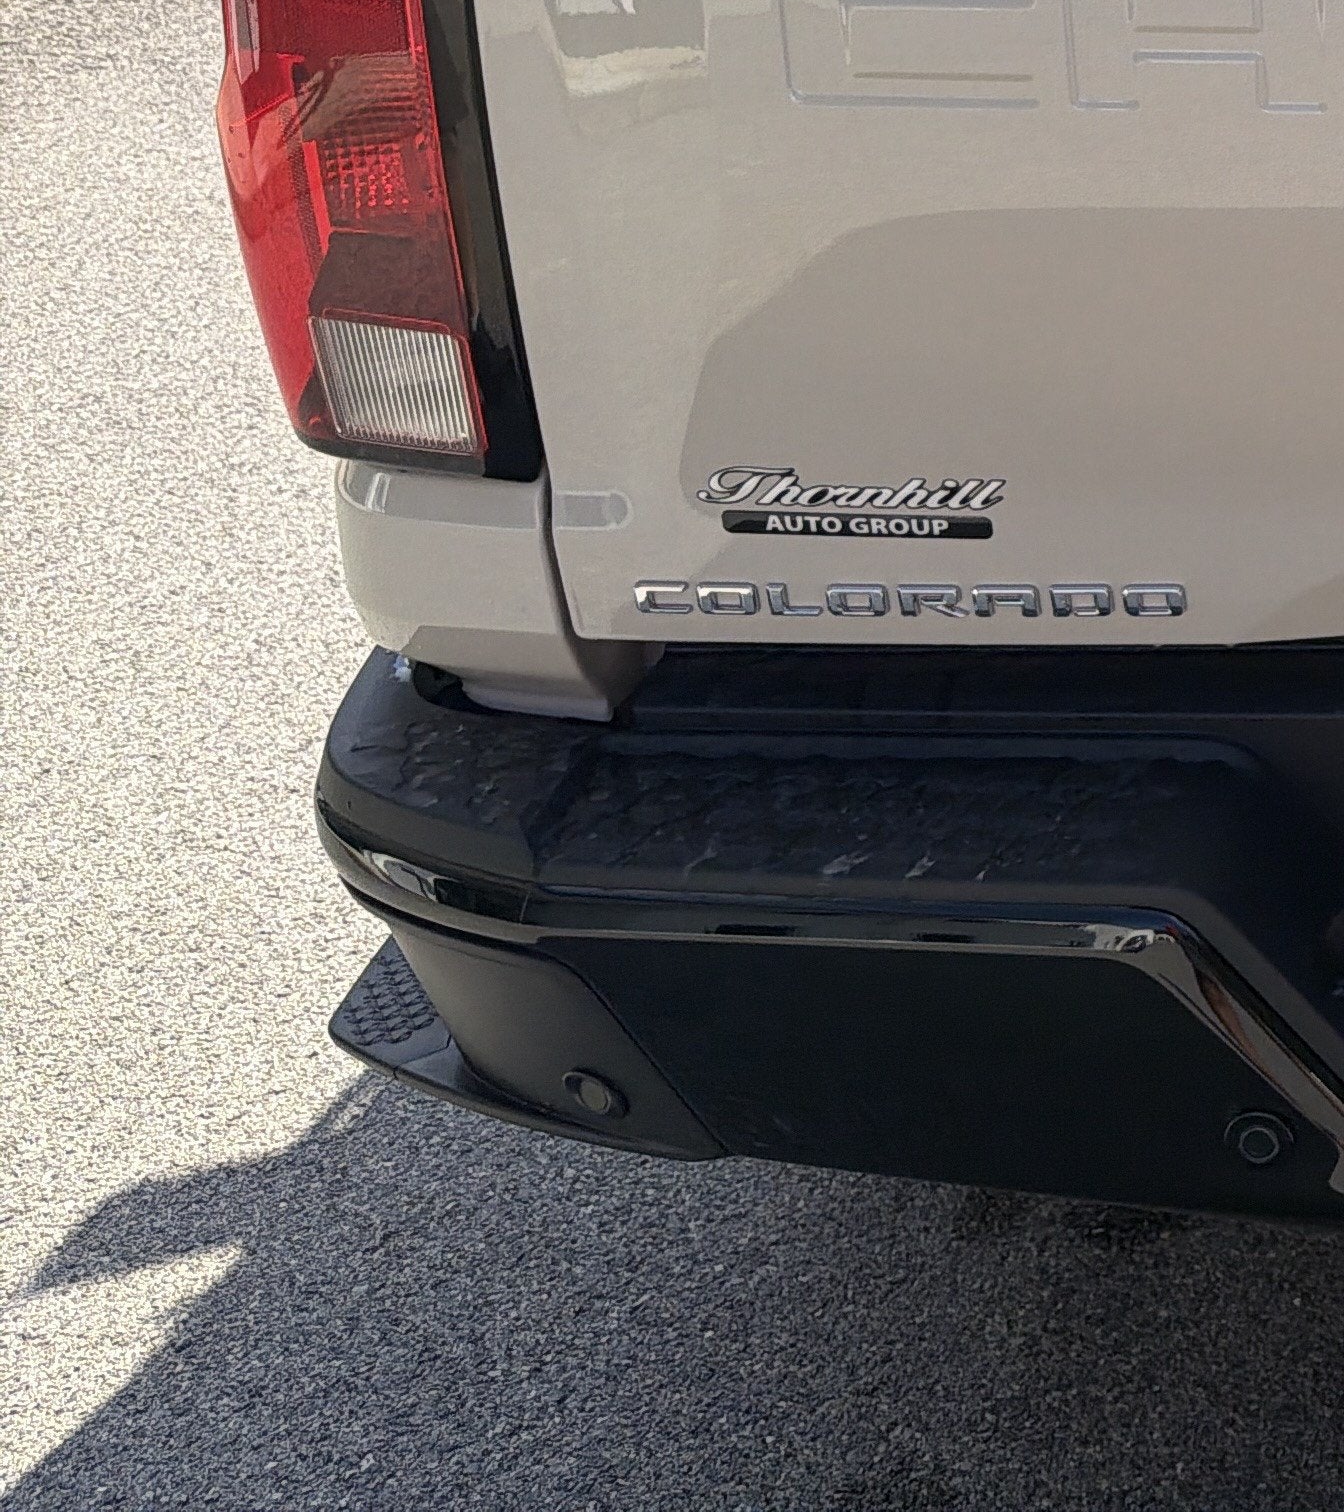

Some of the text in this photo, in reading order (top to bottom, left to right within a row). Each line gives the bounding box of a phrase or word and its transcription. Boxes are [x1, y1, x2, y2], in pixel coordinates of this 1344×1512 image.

[697, 465, 1006, 511] Thornhill
[765, 514, 950, 536] AUTO GROUP
[634, 581, 1187, 618] COLORADO
